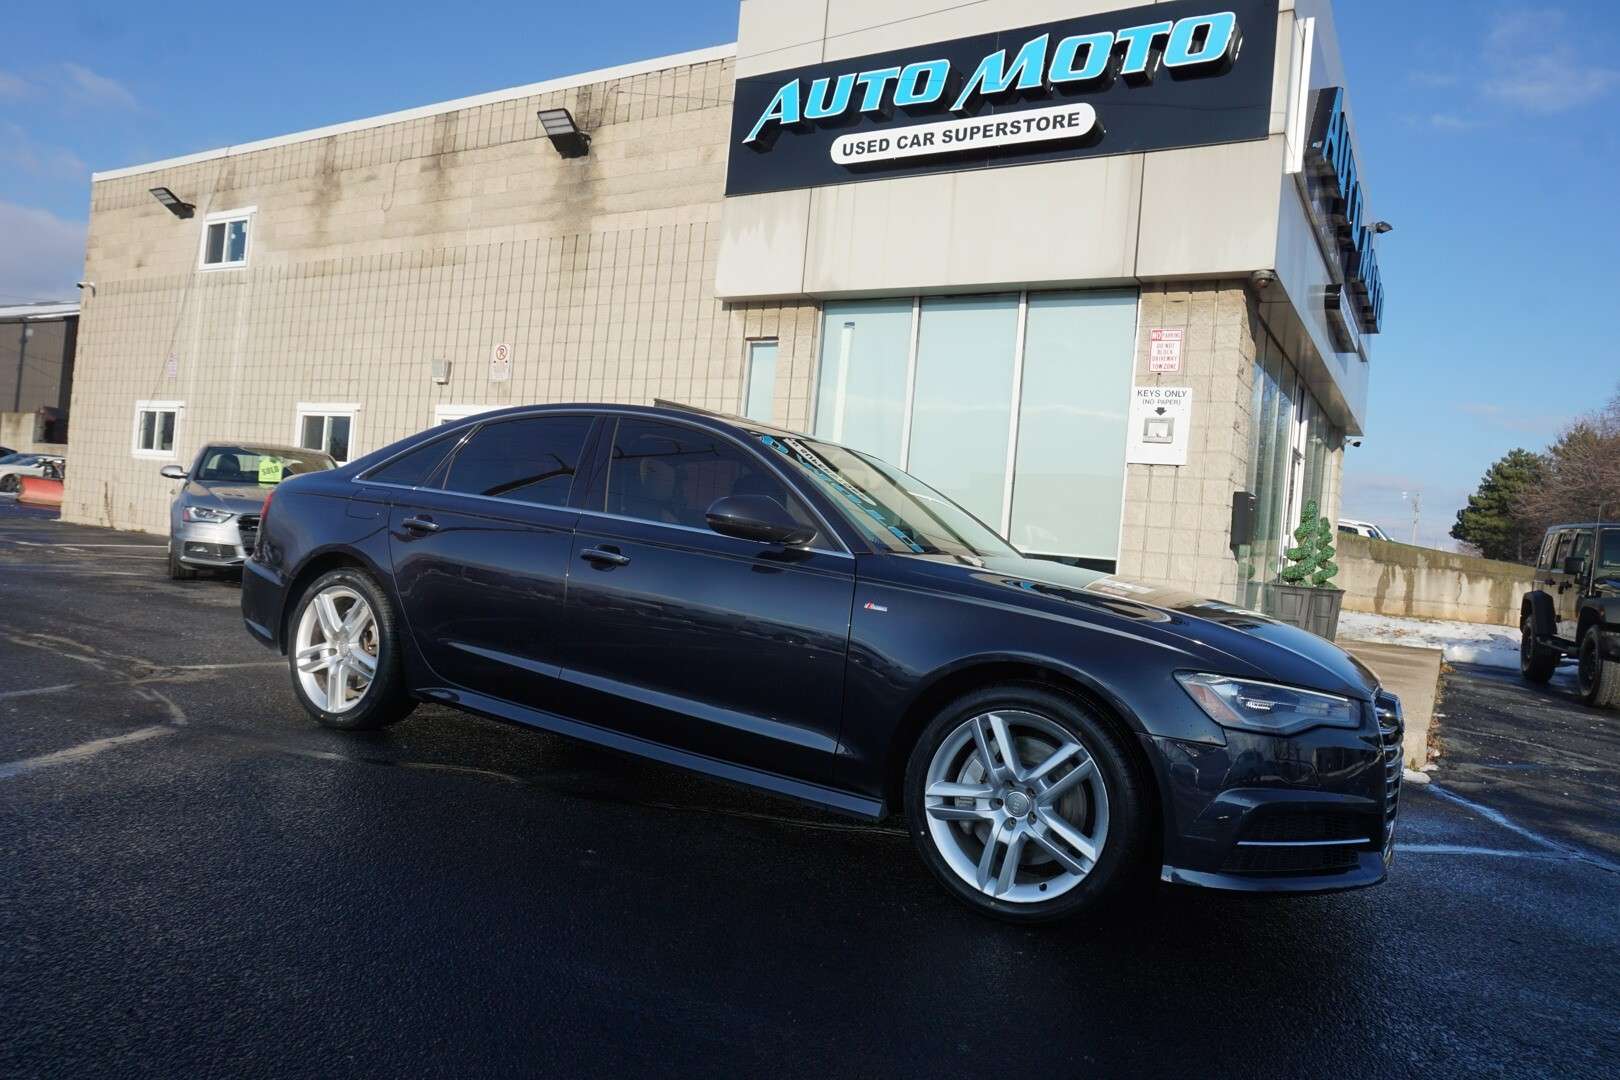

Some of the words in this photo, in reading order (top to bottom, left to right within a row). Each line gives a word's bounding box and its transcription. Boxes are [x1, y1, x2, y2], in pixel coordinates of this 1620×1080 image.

[742, 58, 950, 143] AUTO
[949, 11, 1236, 111] MOTO
[842, 138, 890, 157] USED
[896, 132, 935, 150] CAR
[942, 112, 1081, 144] SUPERSTORE
[1137, 389, 1161, 398] KEYS
[1164, 389, 1187, 398] ONLY
[261, 465, 280, 476] SOLD
